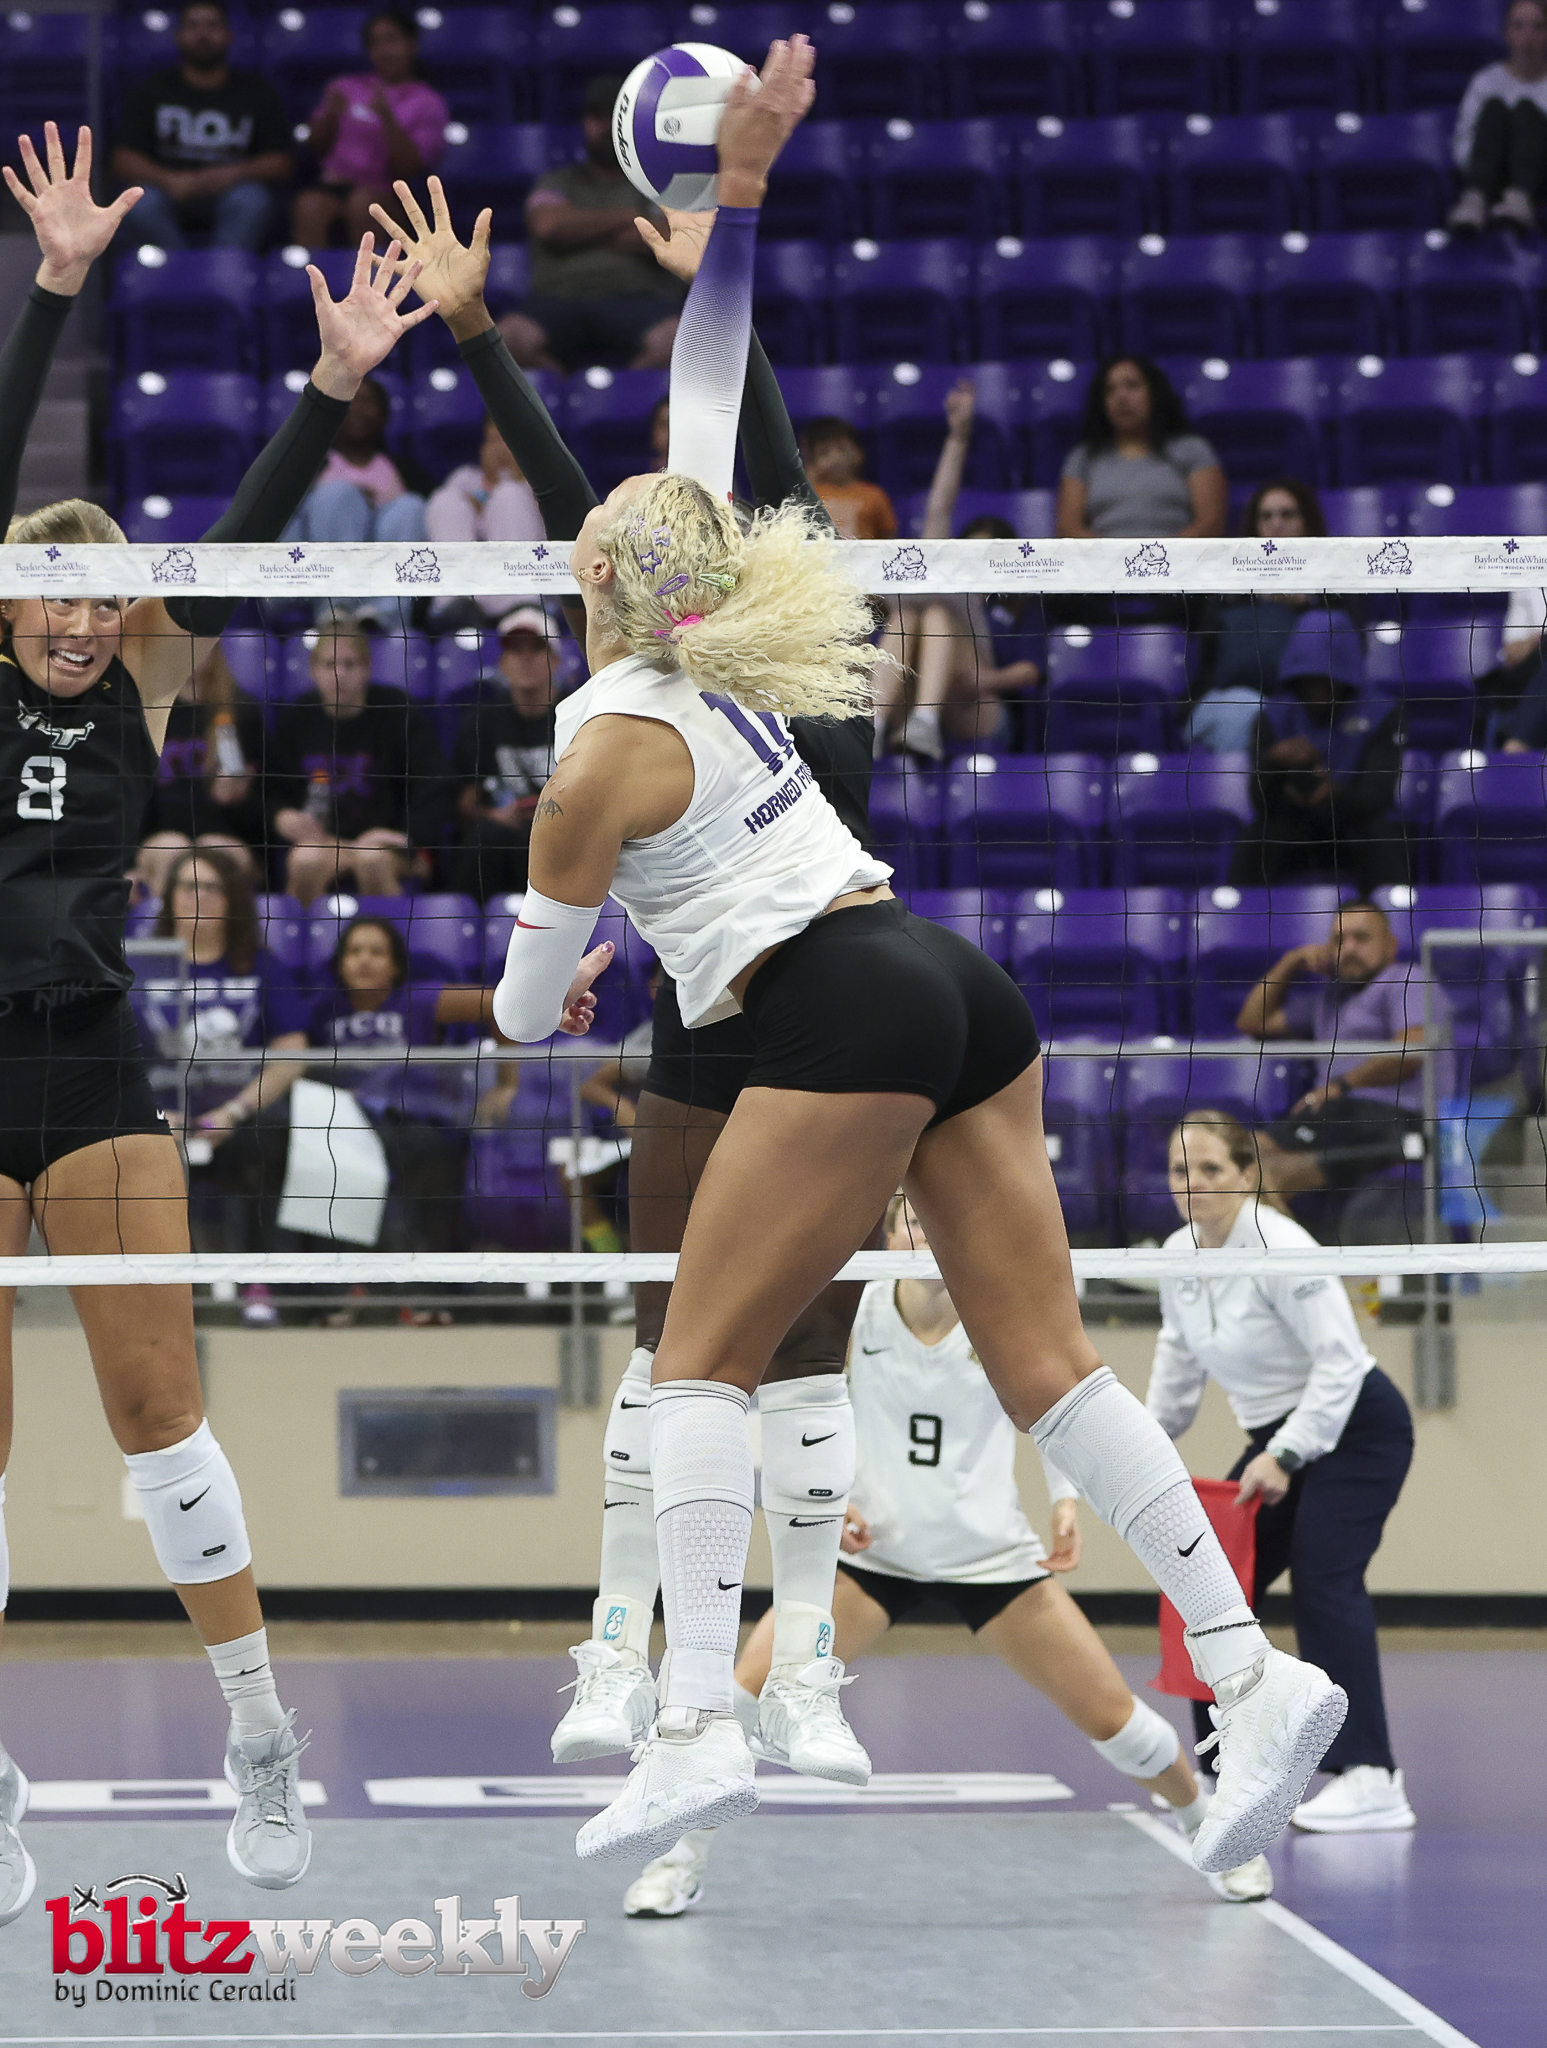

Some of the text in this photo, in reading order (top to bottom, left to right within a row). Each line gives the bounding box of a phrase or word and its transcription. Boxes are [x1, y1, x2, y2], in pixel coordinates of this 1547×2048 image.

[503, 561, 570, 572] BaylorScott&Wh
[17, 755, 67, 821] 8
[744, 777, 802, 835] HORNED
[33, 979, 100, 1012] NIK
[908, 1413, 942, 1467] 9
